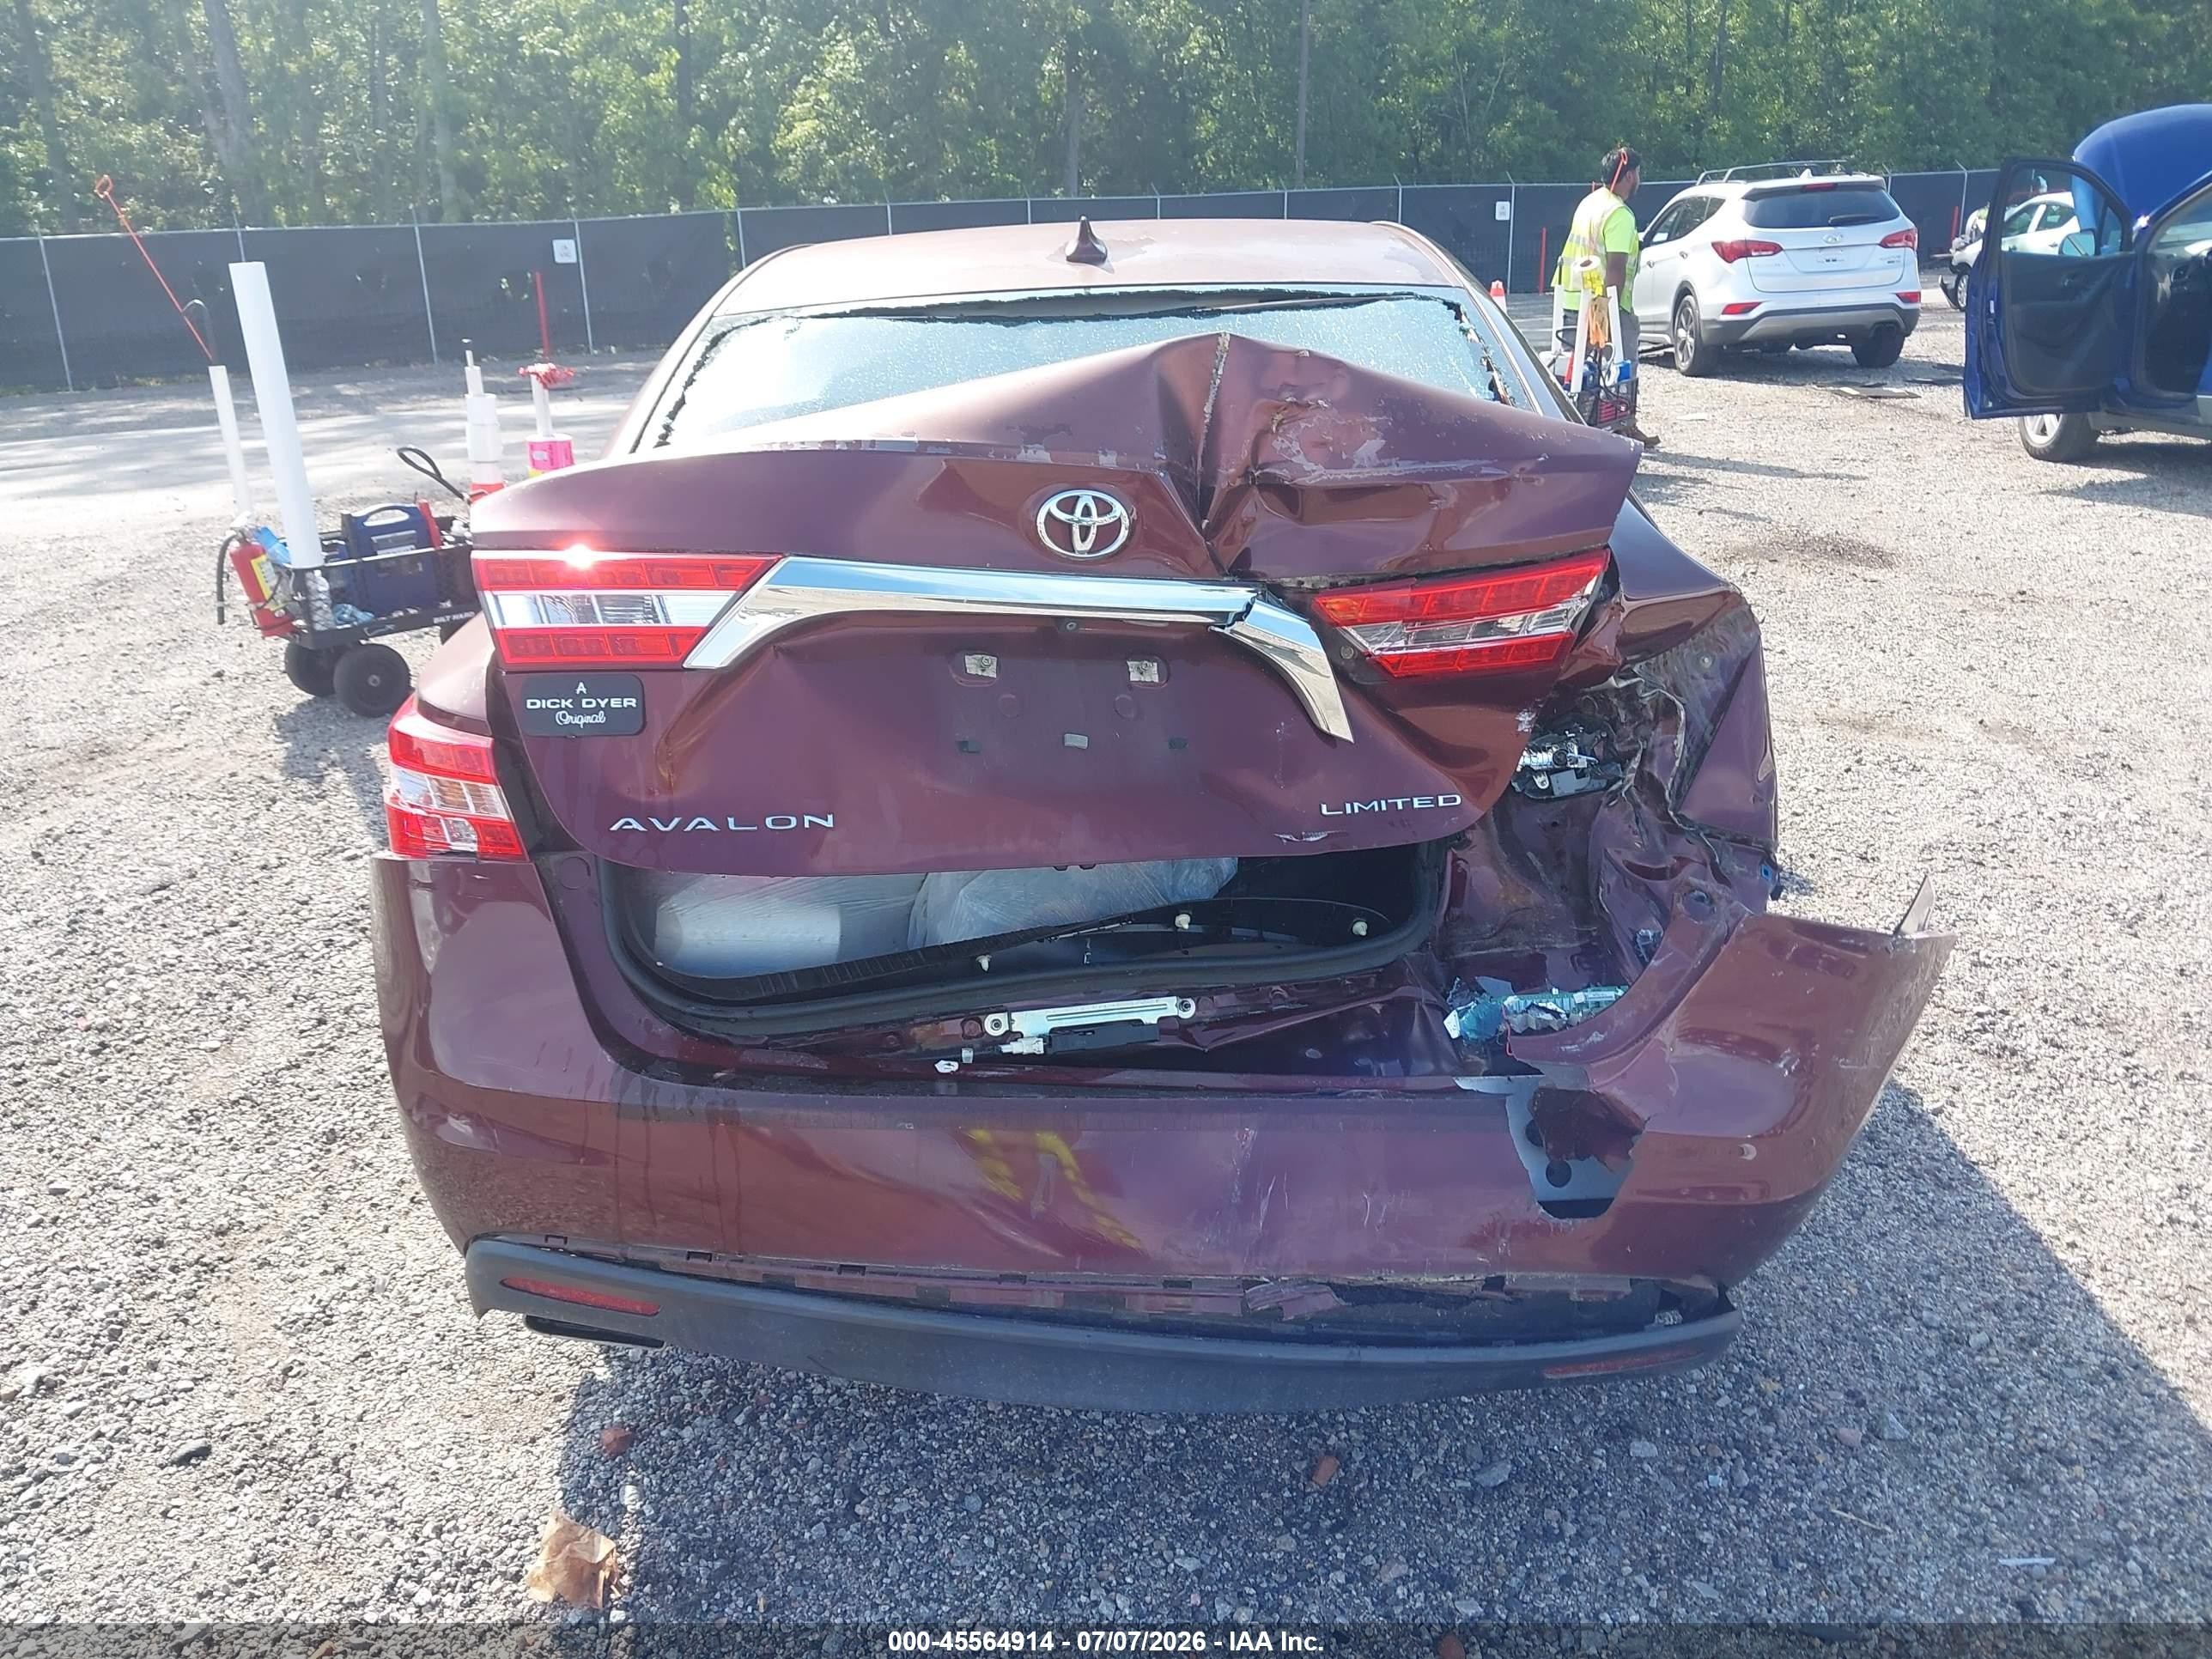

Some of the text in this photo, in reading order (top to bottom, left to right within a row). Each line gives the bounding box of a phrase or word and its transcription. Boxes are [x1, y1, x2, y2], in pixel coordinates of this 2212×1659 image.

[575, 681, 587, 695] A
[526, 697, 637, 709] DICK DYER
[555, 710, 606, 729] Original
[1319, 793, 1462, 816] LIMITED
[609, 812, 835, 832] AVALON
